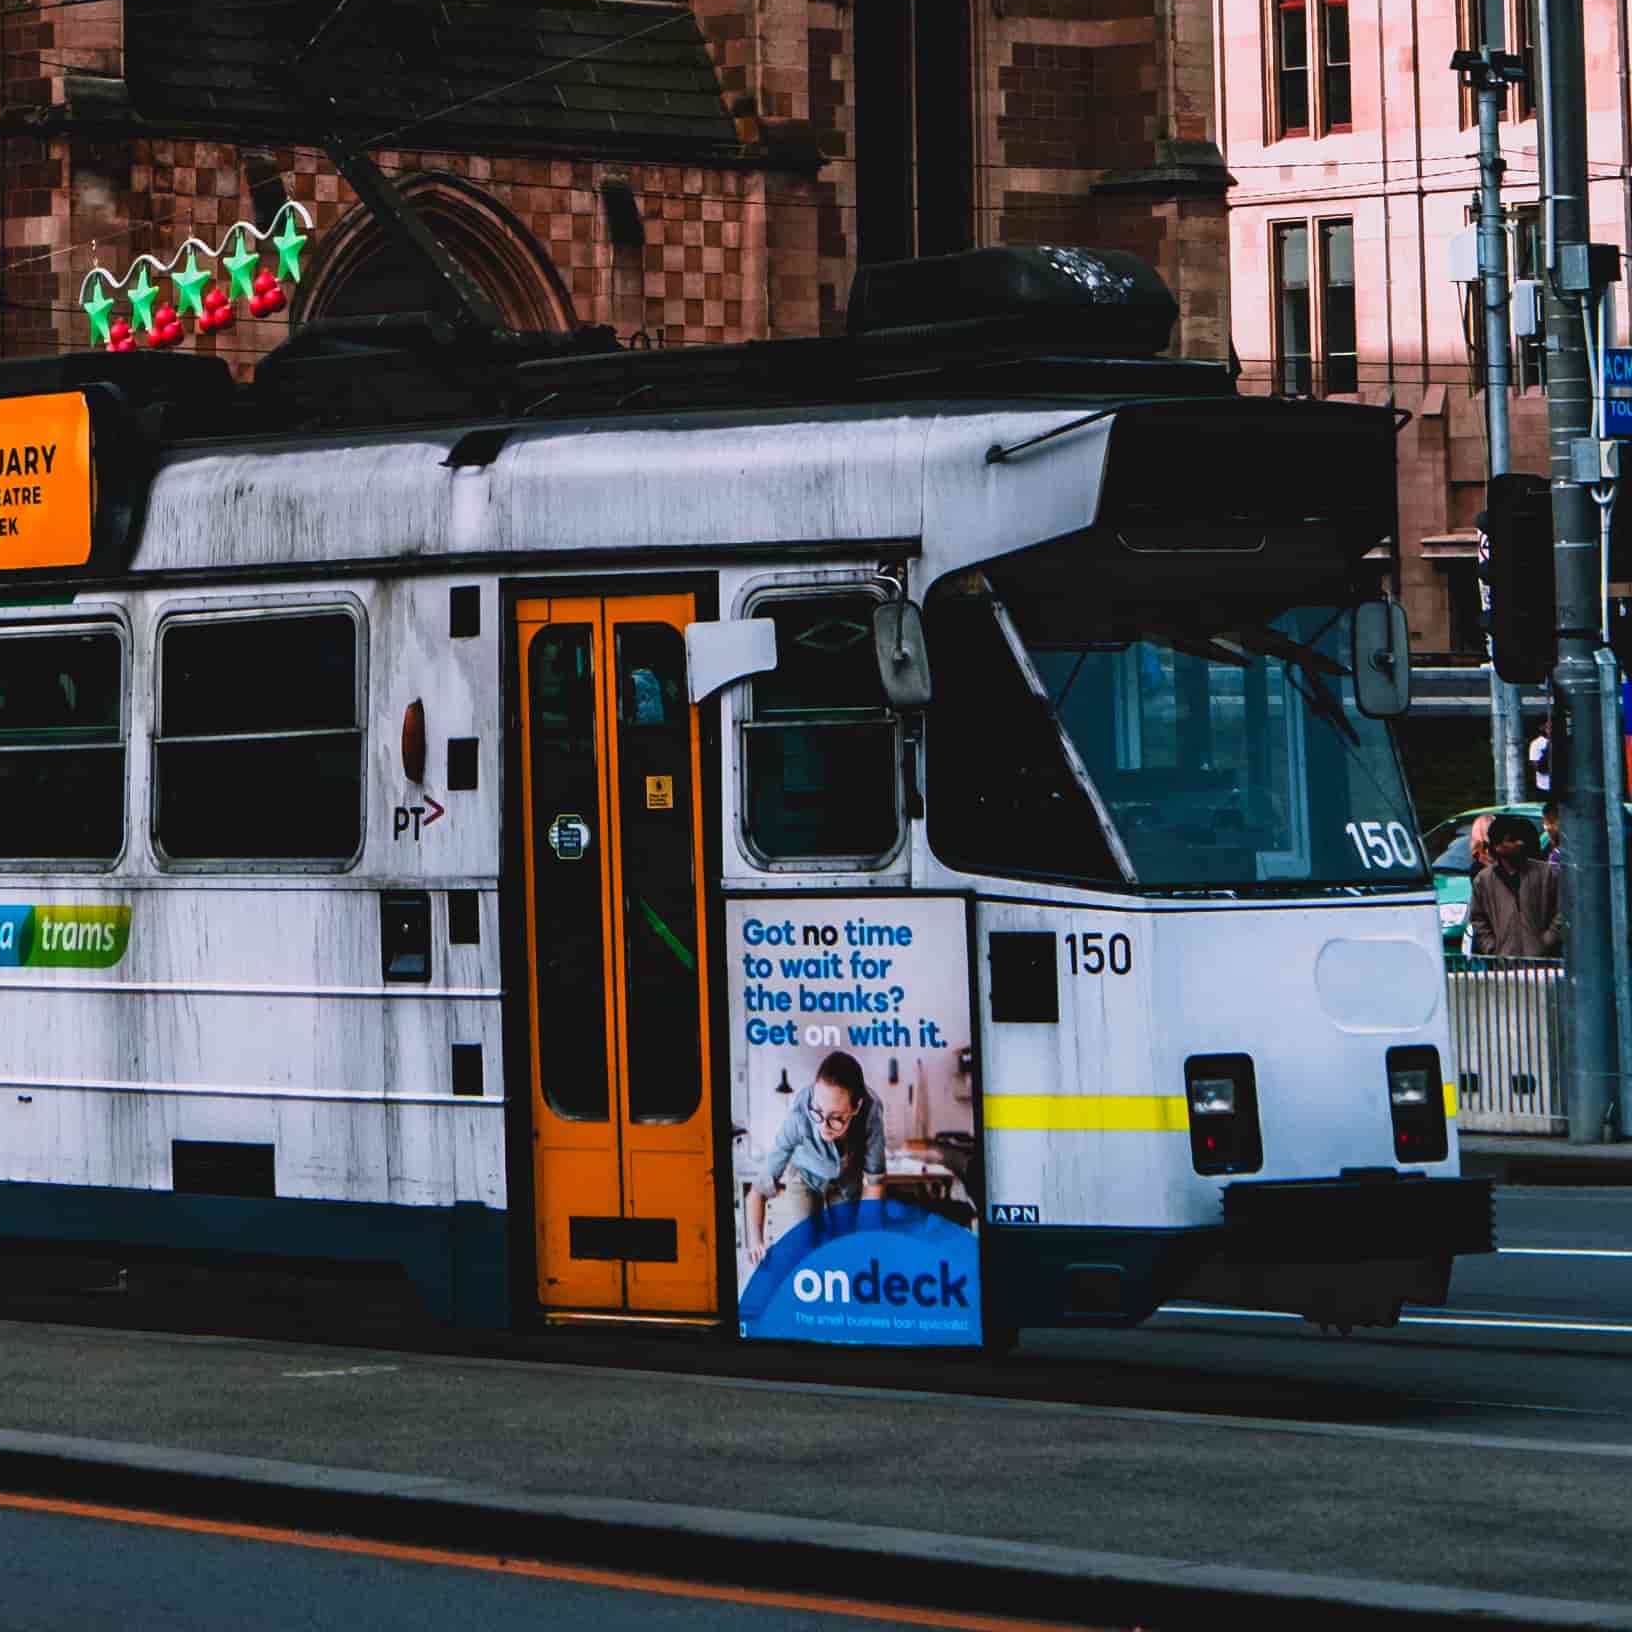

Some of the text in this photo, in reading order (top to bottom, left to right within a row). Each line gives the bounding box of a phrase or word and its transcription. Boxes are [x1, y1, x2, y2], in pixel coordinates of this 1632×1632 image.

[1344, 821, 1417, 869] 150
[41, 916, 116, 952] trams
[743, 917, 913, 946] Got no time
[743, 950, 893, 979] to wait for
[1064, 932, 1132, 975] 150
[744, 984, 905, 1012] the banks?
[746, 1018, 948, 1048] Get on with it.
[995, 1206, 1038, 1222] APN
[792, 1258, 970, 1309] ondeck
